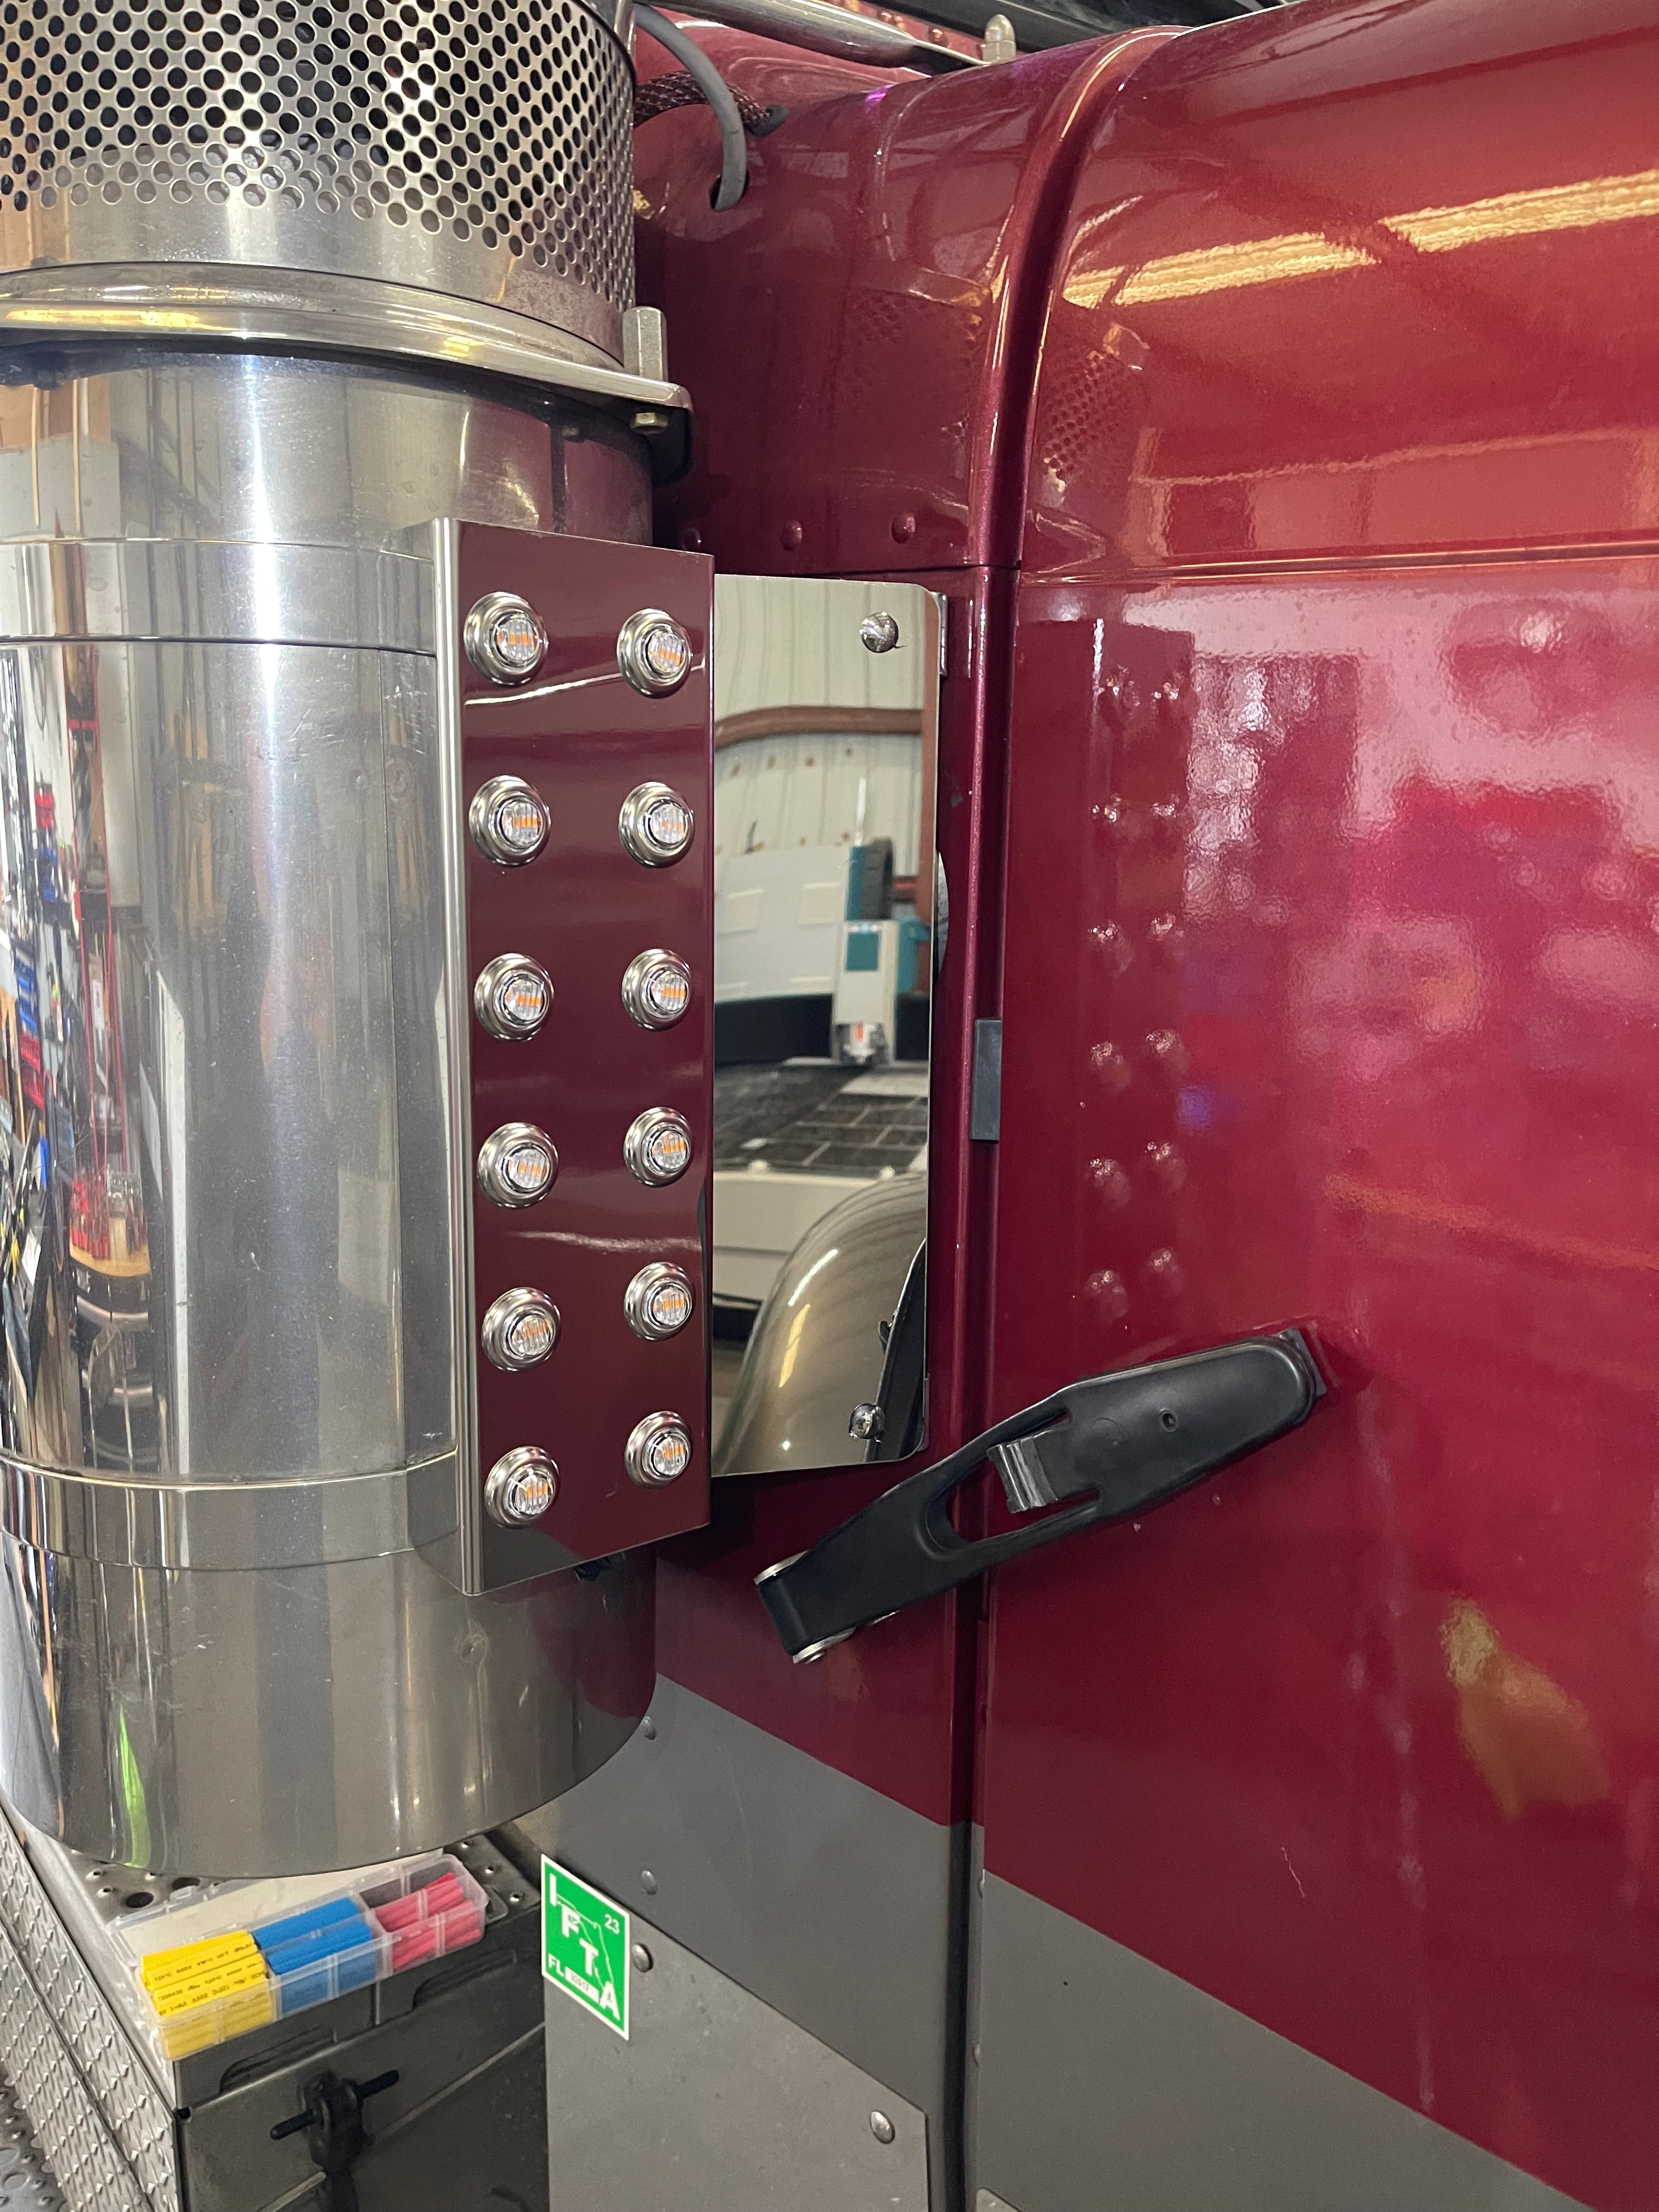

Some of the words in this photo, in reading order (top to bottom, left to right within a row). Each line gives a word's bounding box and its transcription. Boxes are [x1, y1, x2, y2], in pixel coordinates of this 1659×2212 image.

[605, 1913, 620, 1934] 23
[549, 1873, 620, 2021] IFTA
[548, 1953, 565, 1977] FL
